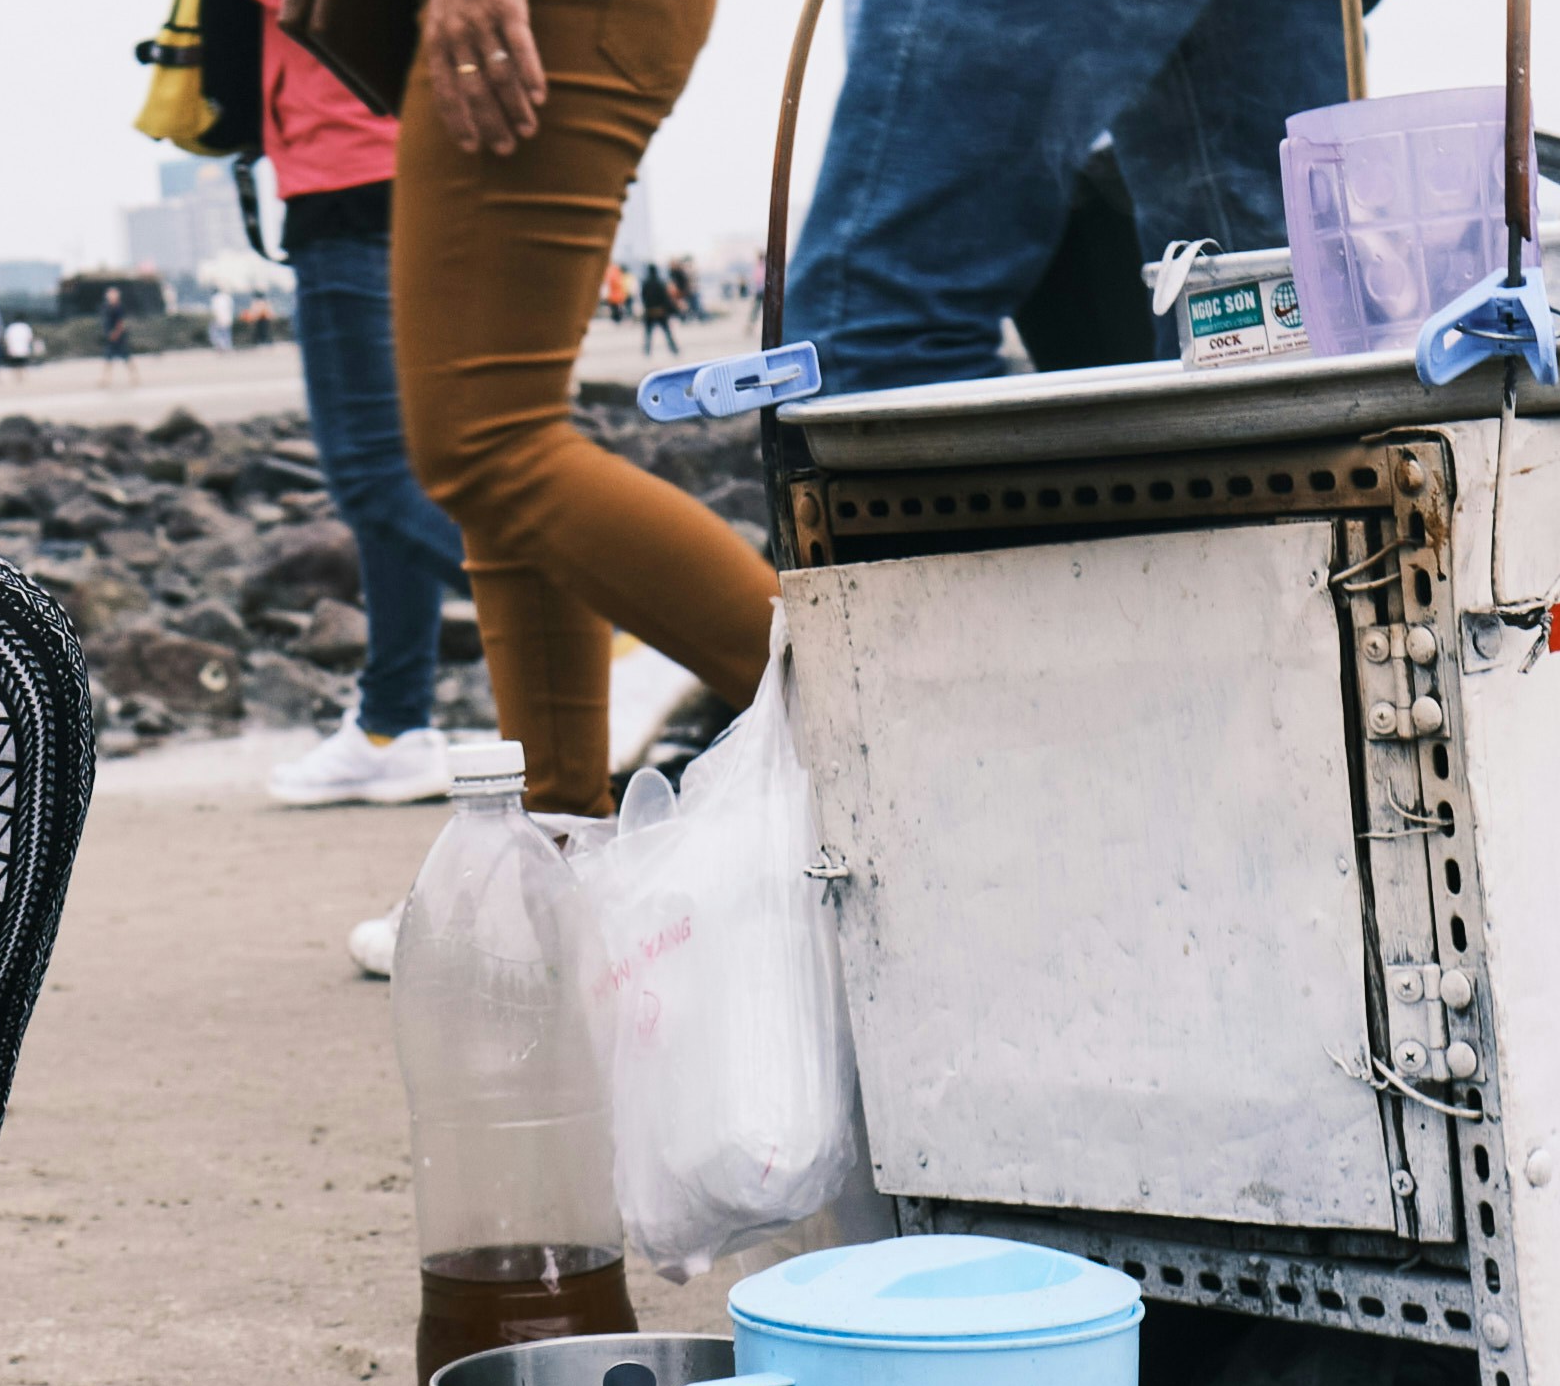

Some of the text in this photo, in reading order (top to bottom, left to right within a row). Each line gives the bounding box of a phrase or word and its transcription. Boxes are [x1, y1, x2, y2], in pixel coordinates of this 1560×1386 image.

[1191, 290, 1256, 322] NGỌC SƠN
[1209, 334, 1242, 349] COCK
